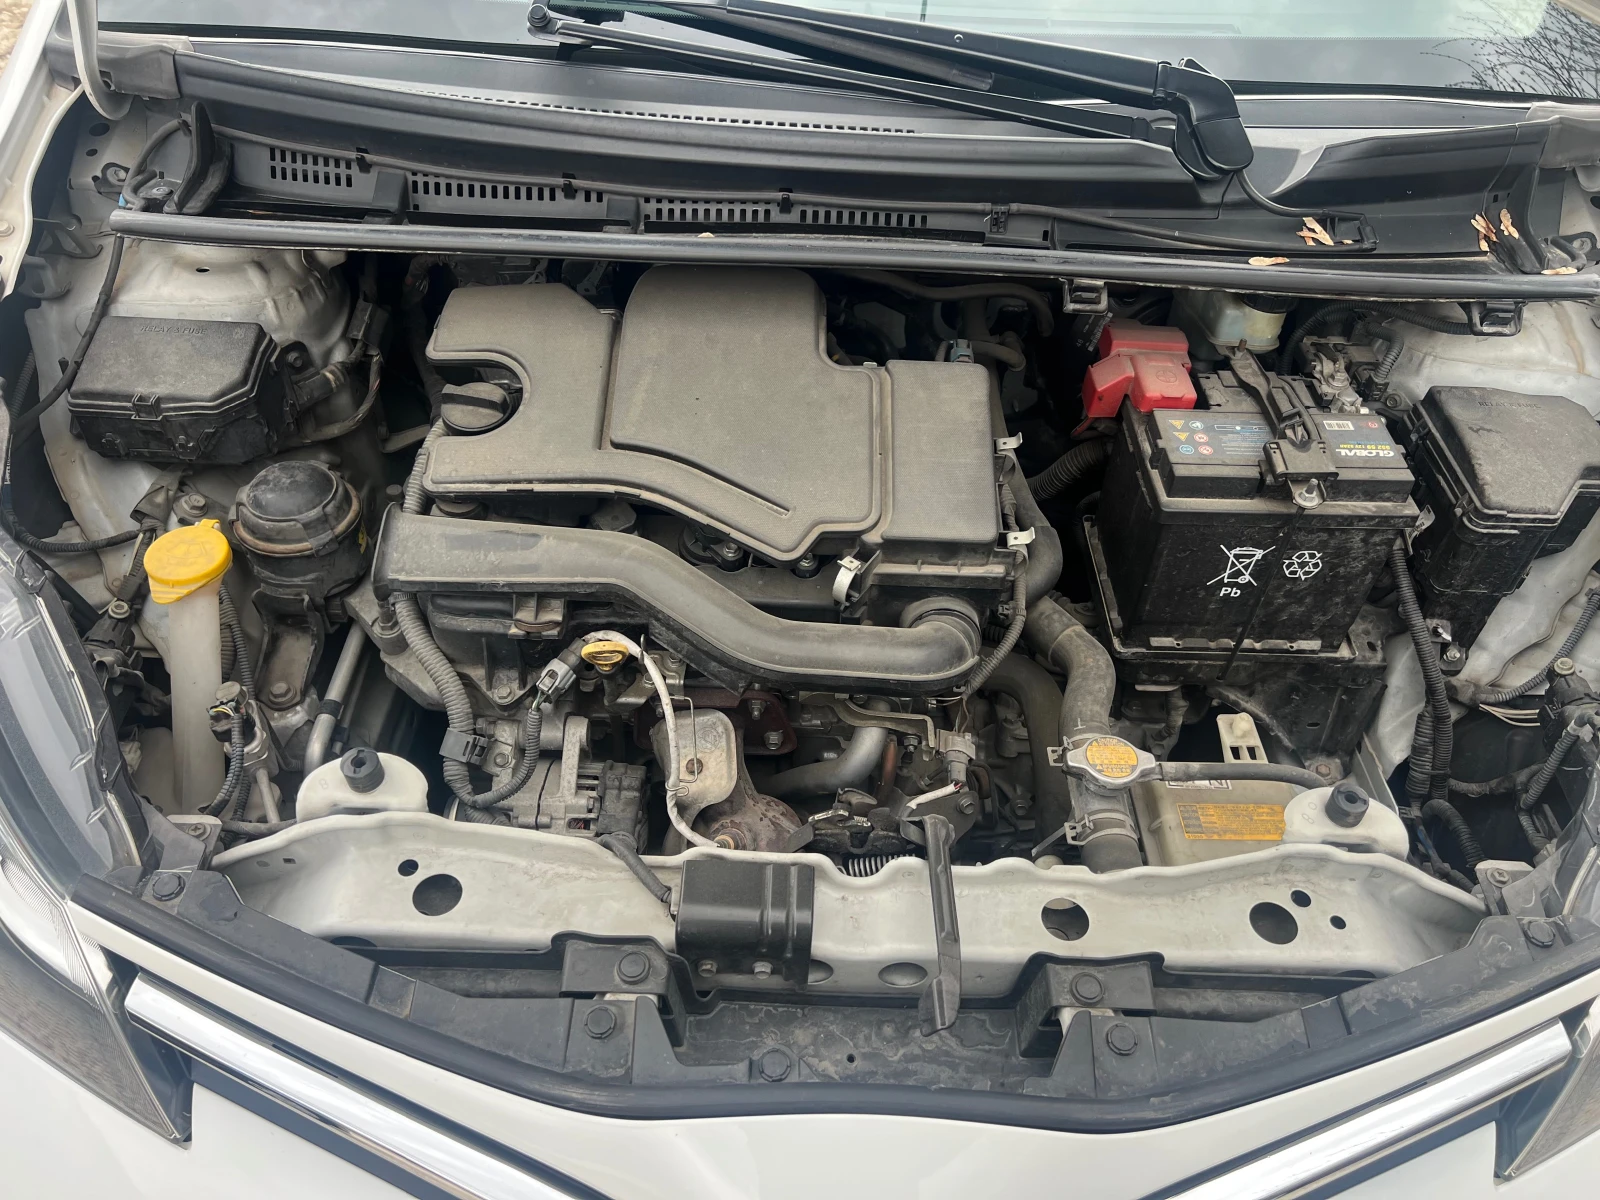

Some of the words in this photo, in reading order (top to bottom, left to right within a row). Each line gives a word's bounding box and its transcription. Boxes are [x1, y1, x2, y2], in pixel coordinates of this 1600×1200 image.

[141, 325, 172, 333] RELAY
[182, 326, 208, 335] FUSE
[1335, 448, 1395, 457] GLOBAL
[1219, 586, 1241, 597] Pb
